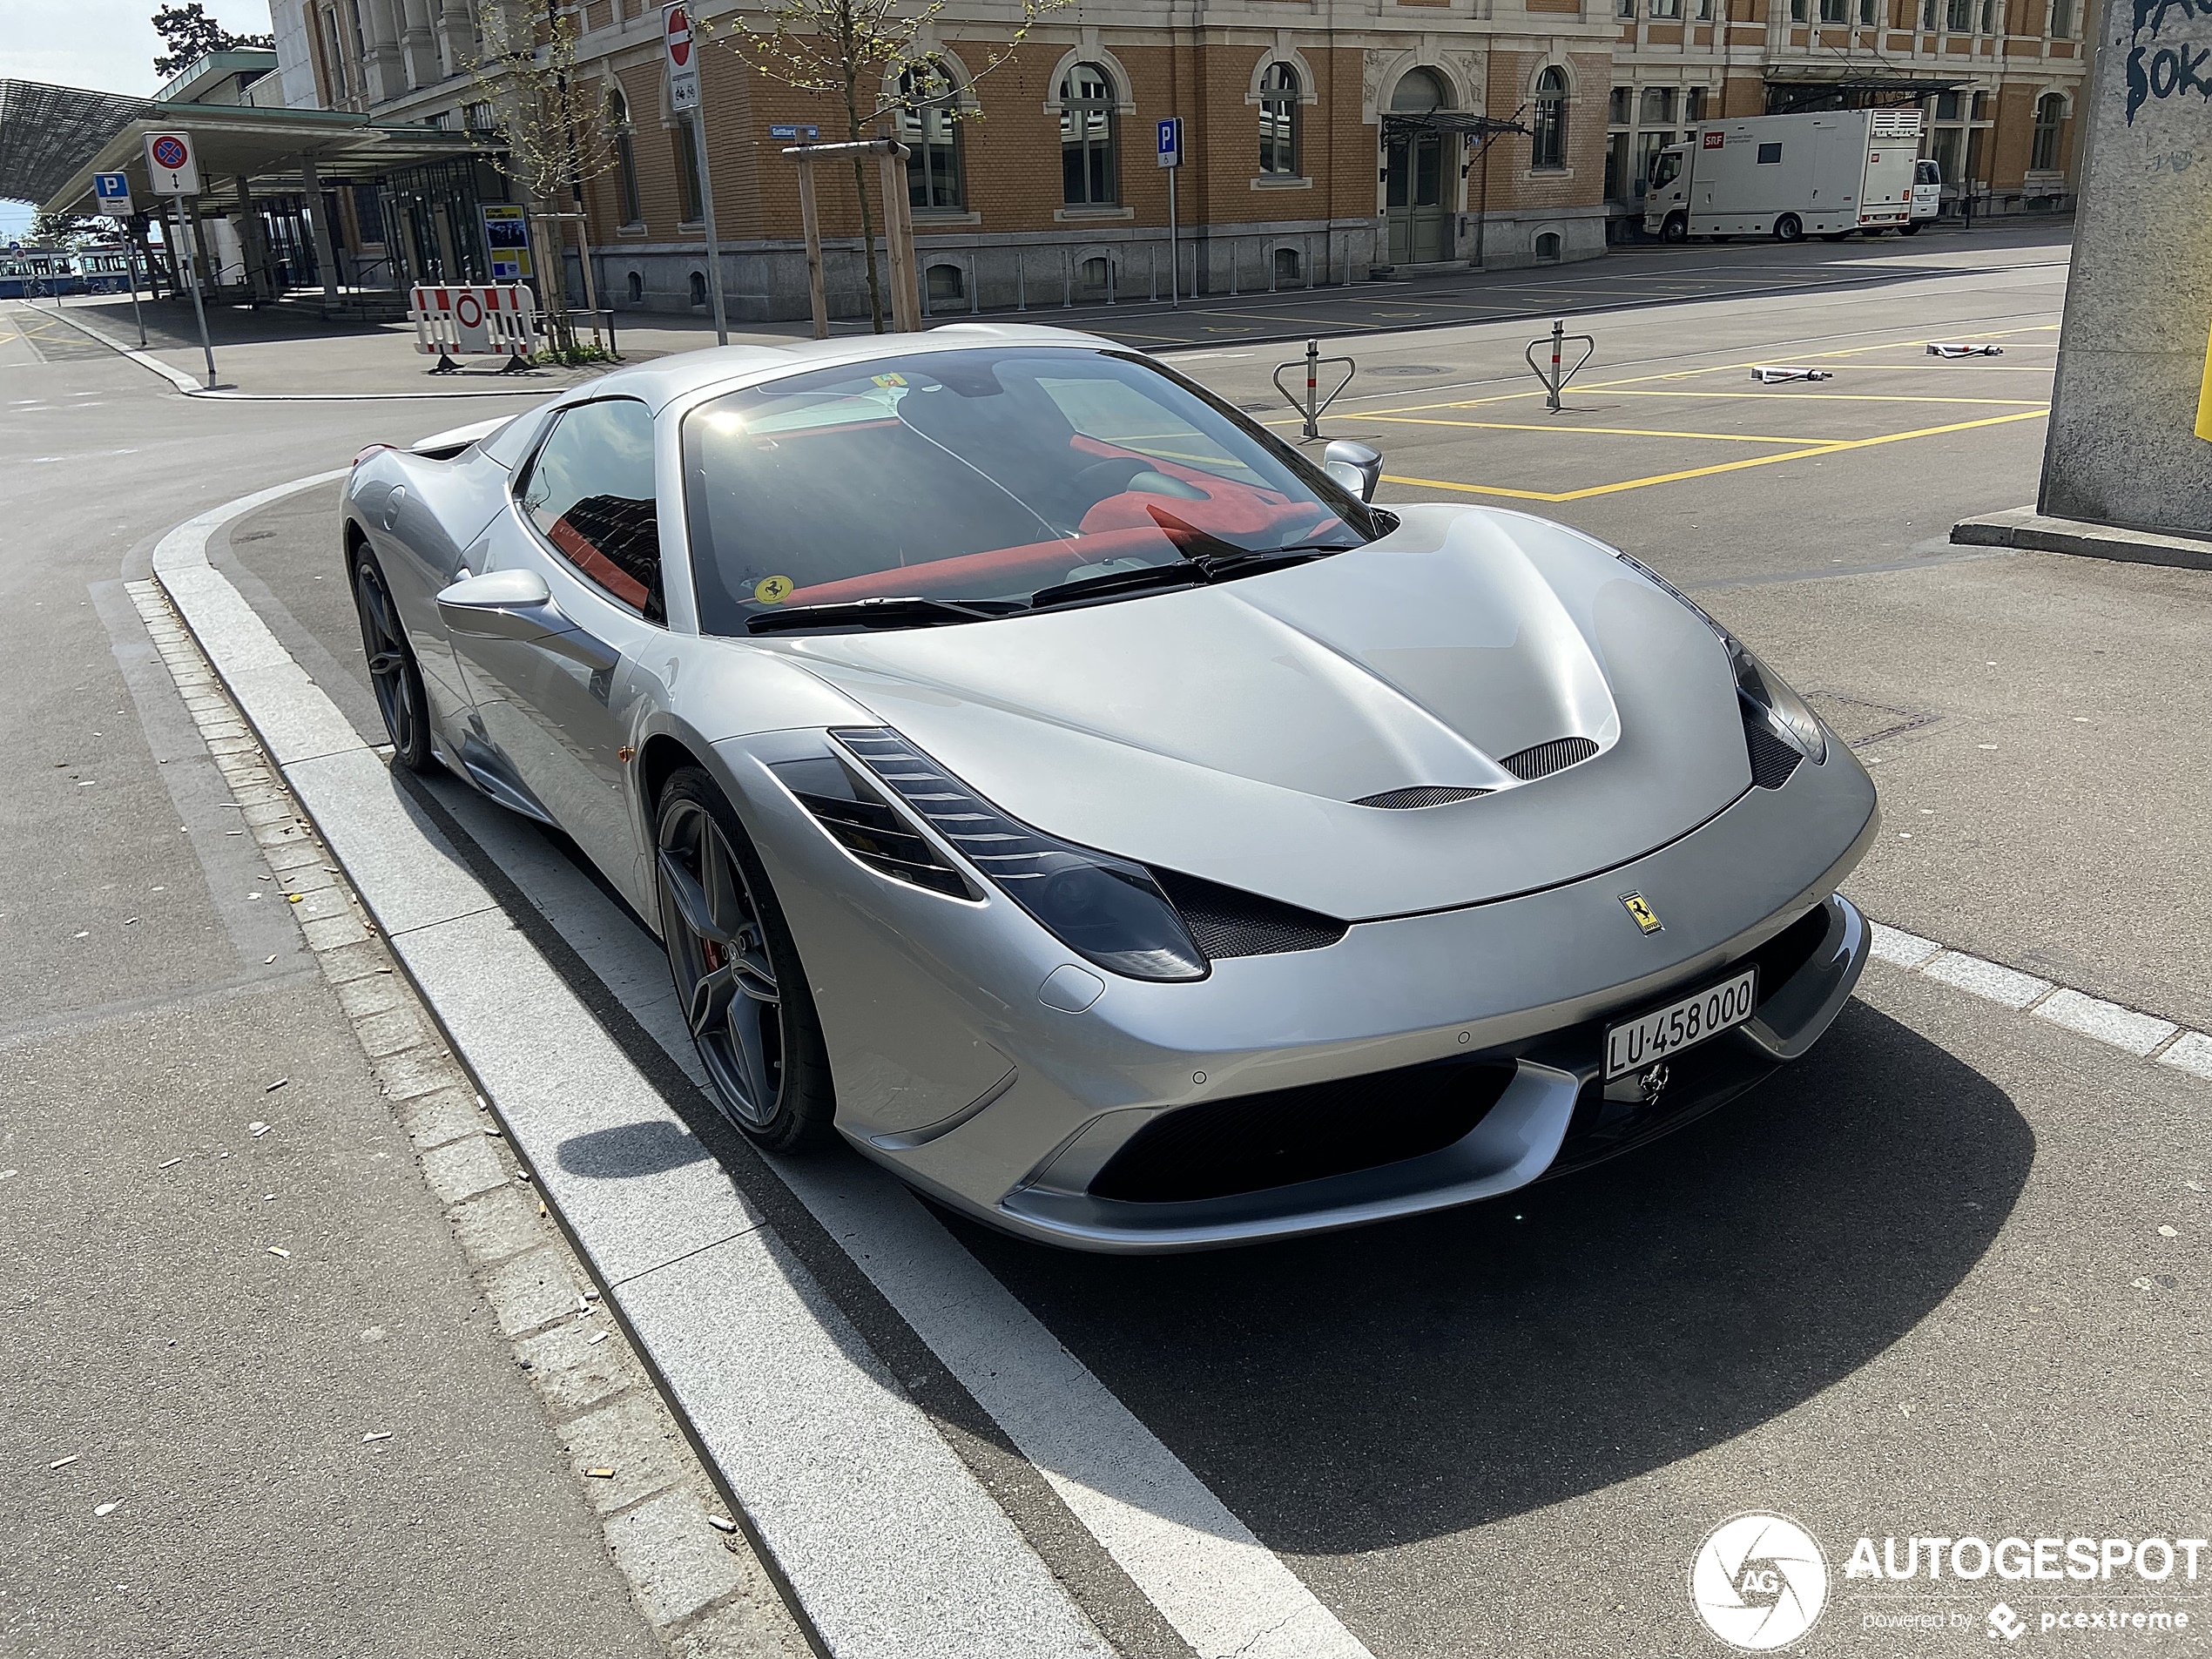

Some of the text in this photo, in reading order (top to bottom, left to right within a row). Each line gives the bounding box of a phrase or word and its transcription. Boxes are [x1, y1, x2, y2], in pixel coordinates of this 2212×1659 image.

[1162, 125, 1170, 150] P
[1704, 135, 1723, 145] SRF
[103, 177, 118, 195] P
